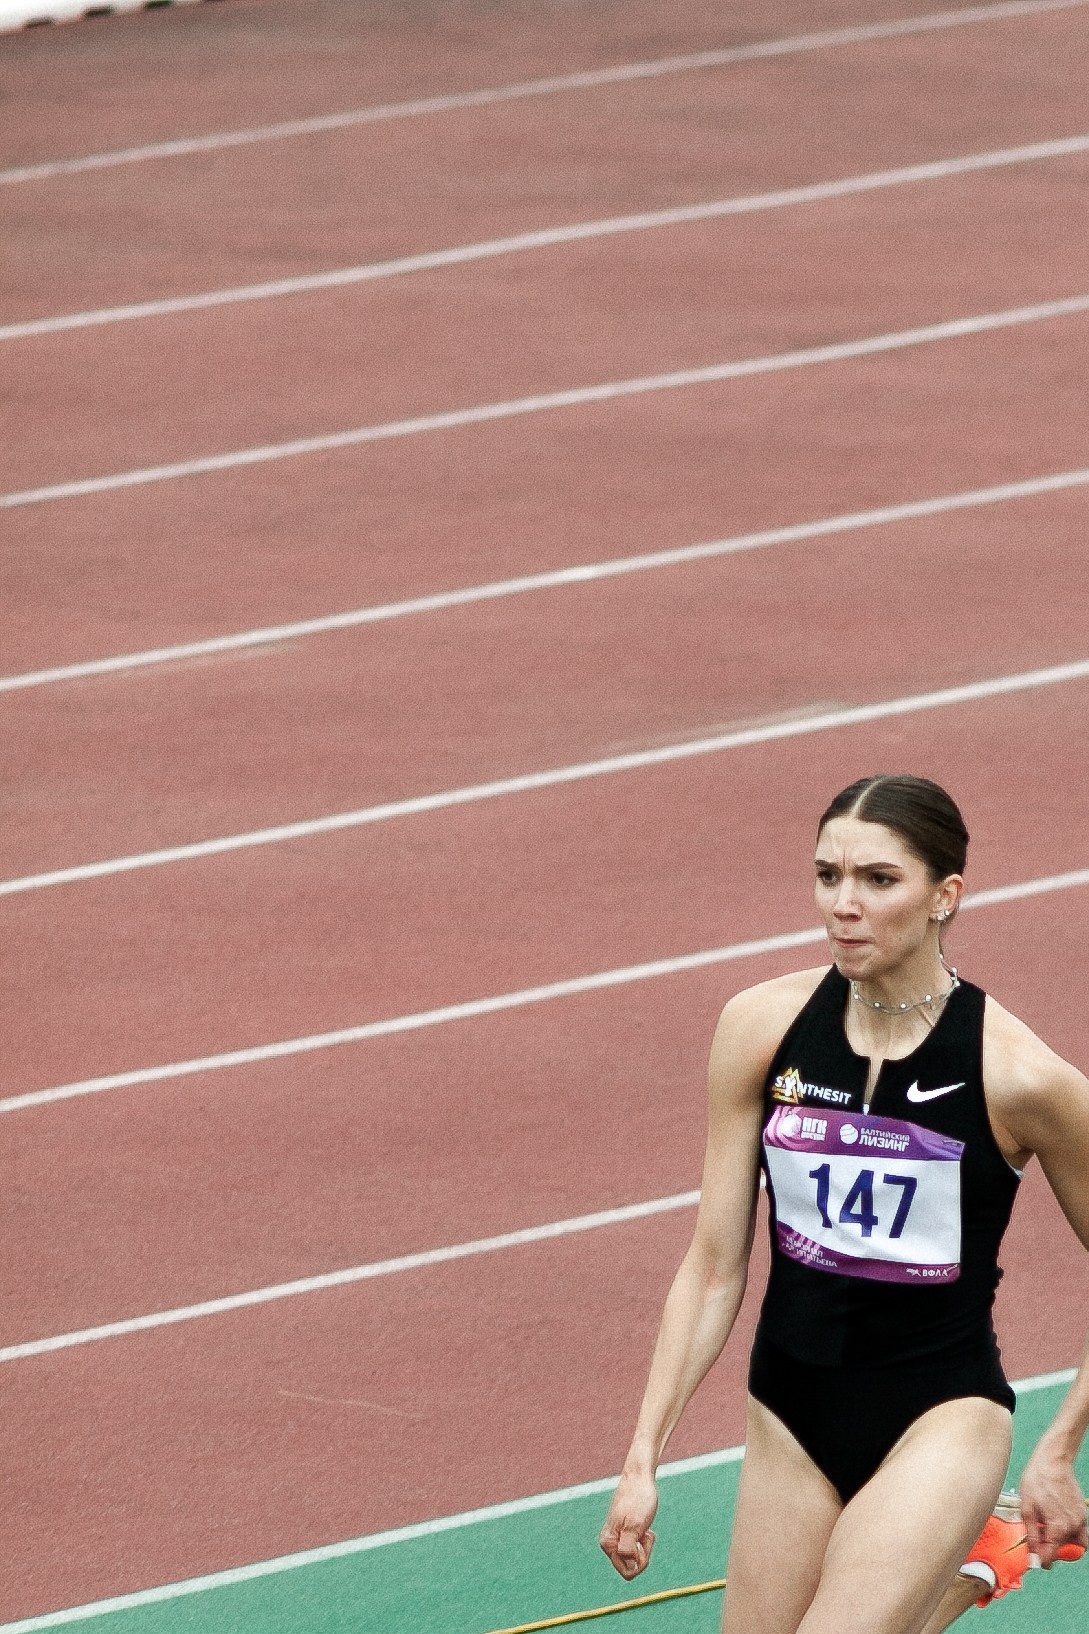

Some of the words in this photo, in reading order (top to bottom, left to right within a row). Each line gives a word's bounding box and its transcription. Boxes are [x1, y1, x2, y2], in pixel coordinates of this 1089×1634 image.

[858, 1134, 910, 1153] ЛИЗИНГ
[860, 1127, 910, 1143] БАЛТИЙСКИЙ
[809, 1163, 918, 1239] 147
